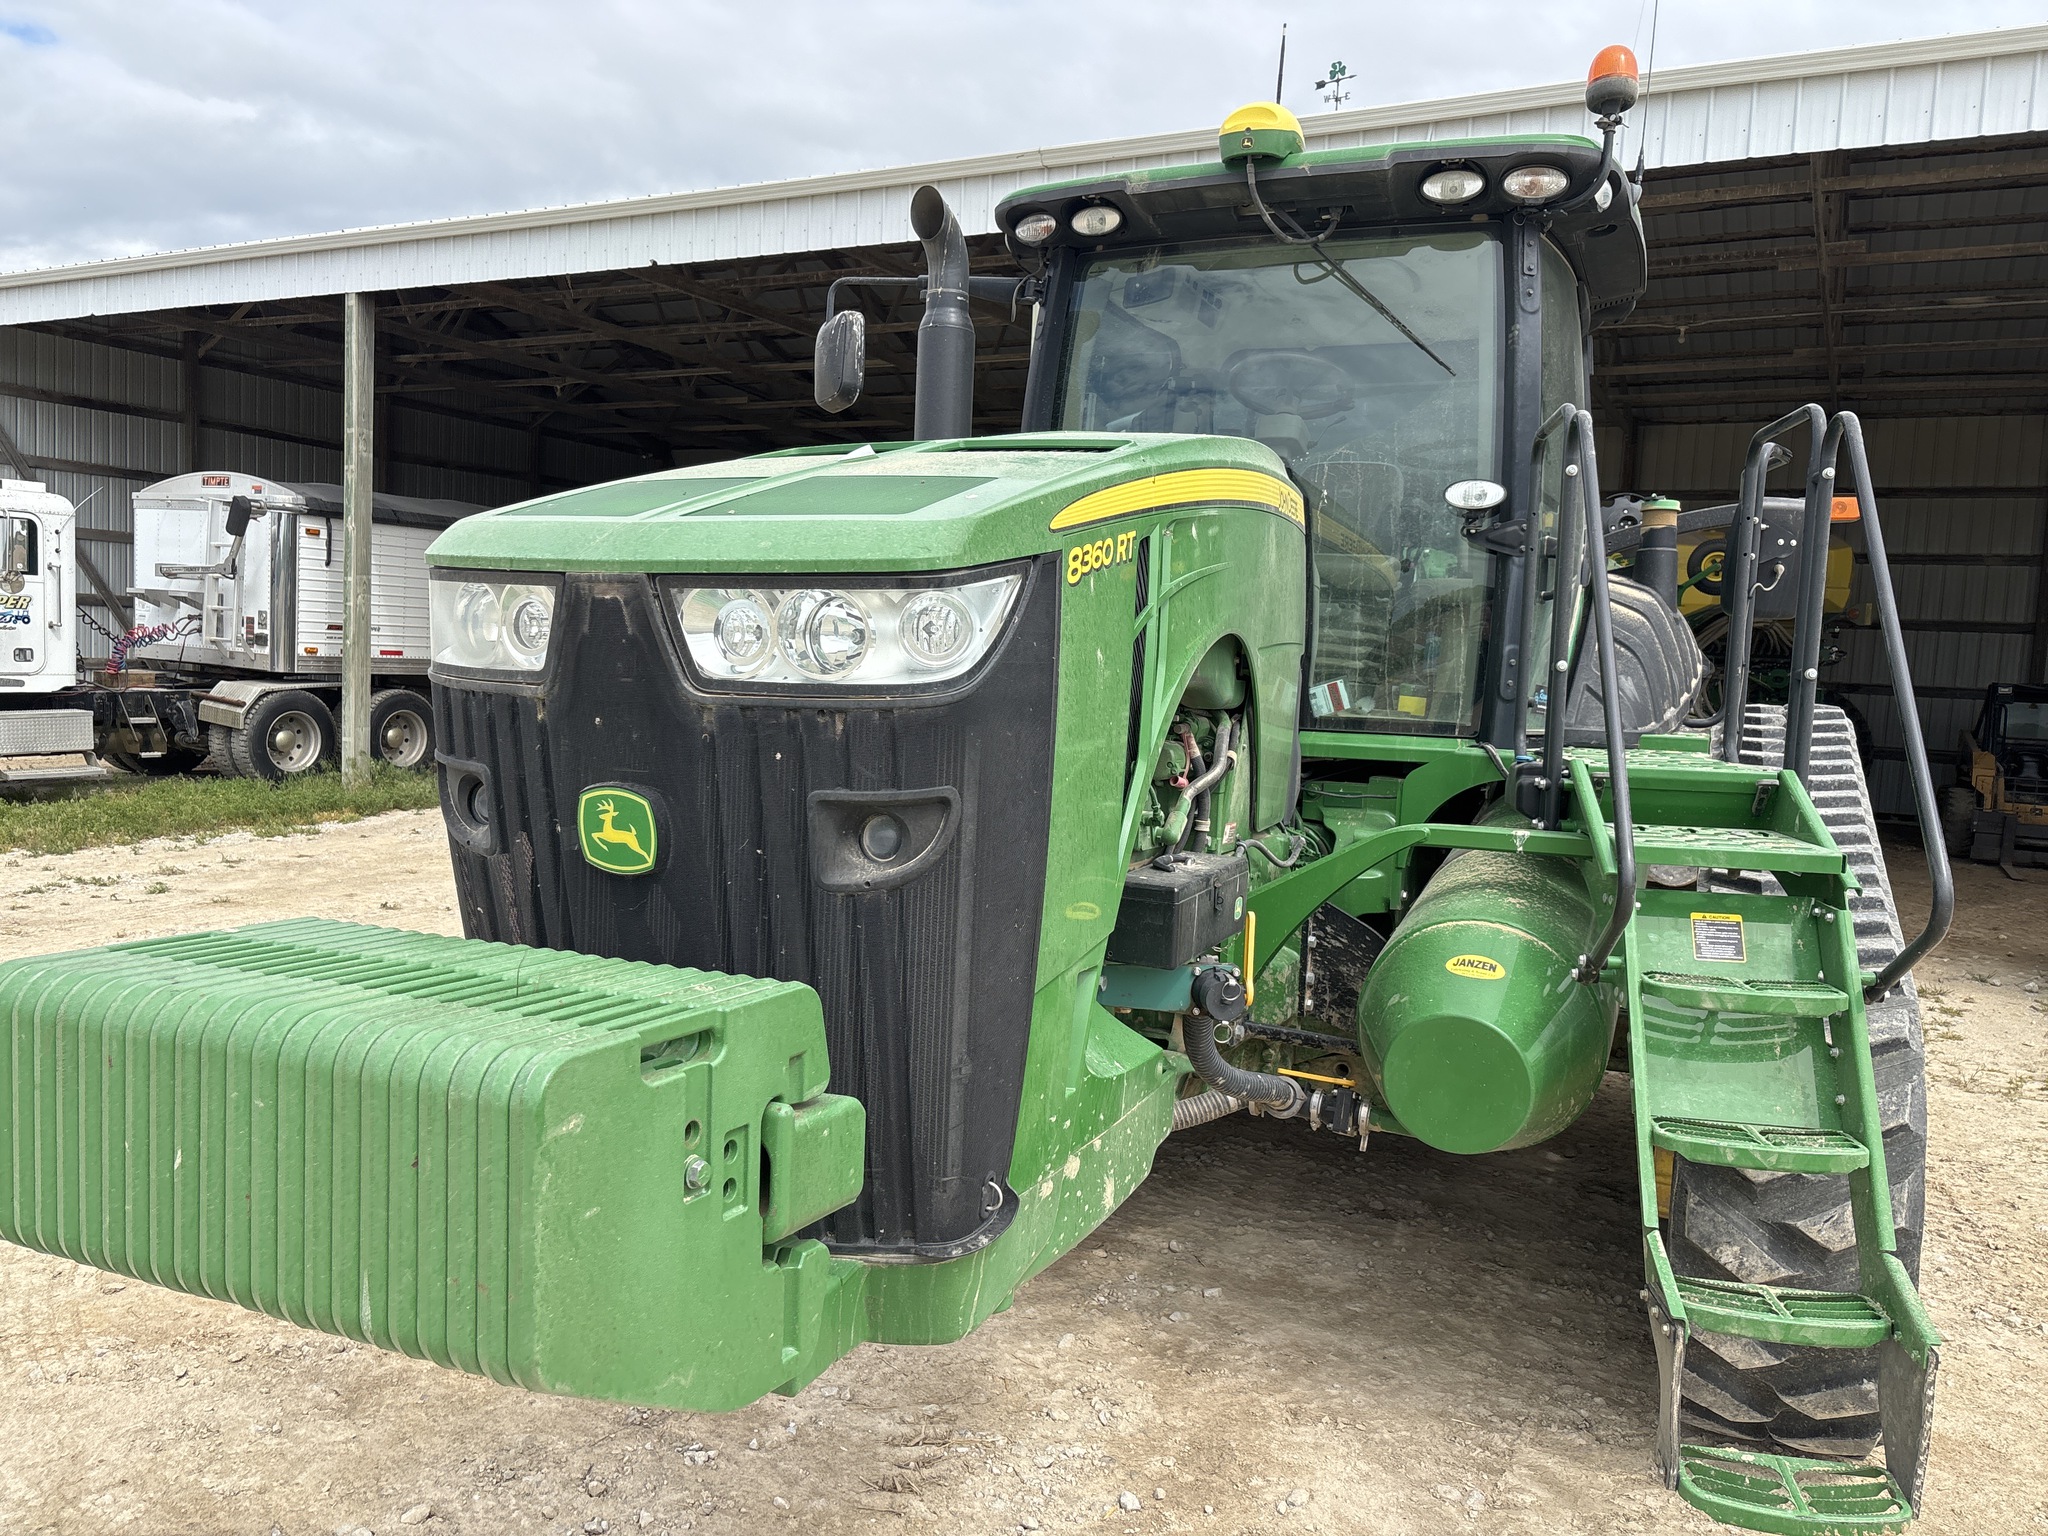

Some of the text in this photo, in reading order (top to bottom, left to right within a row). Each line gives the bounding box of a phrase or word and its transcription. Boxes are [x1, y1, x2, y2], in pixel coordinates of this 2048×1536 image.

[203, 477, 230, 486] TIMPTE
[1067, 530, 1137, 587] 8360 RT
[1452, 957, 1498, 973] JANZEN
